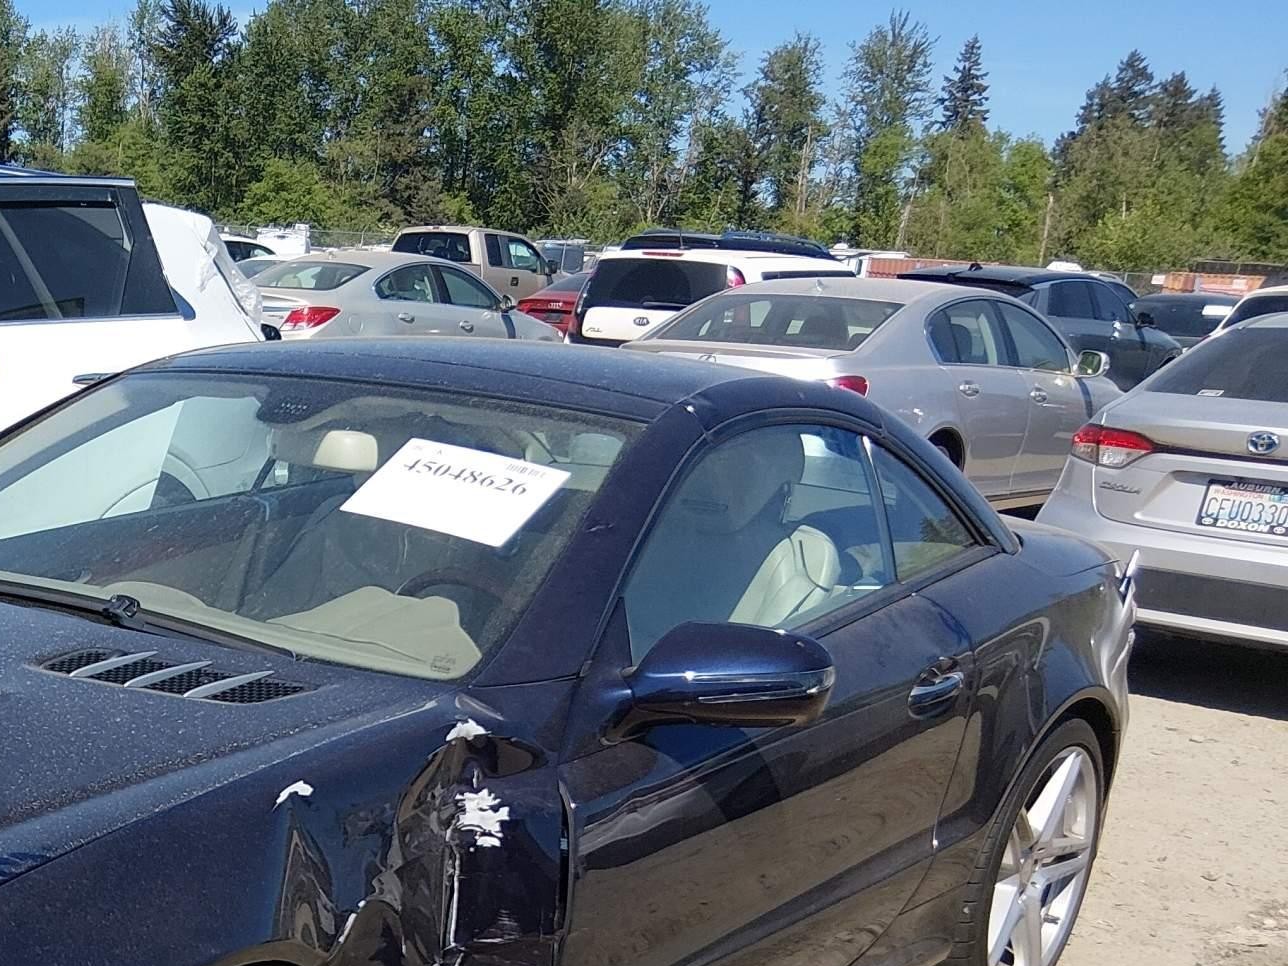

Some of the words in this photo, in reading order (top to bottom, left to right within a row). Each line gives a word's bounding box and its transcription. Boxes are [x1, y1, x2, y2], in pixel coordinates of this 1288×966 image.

[403, 458, 527, 496] 45048626
[1205, 496, 1288, 526] CFU0330
[1215, 518, 1271, 533] DOXON
